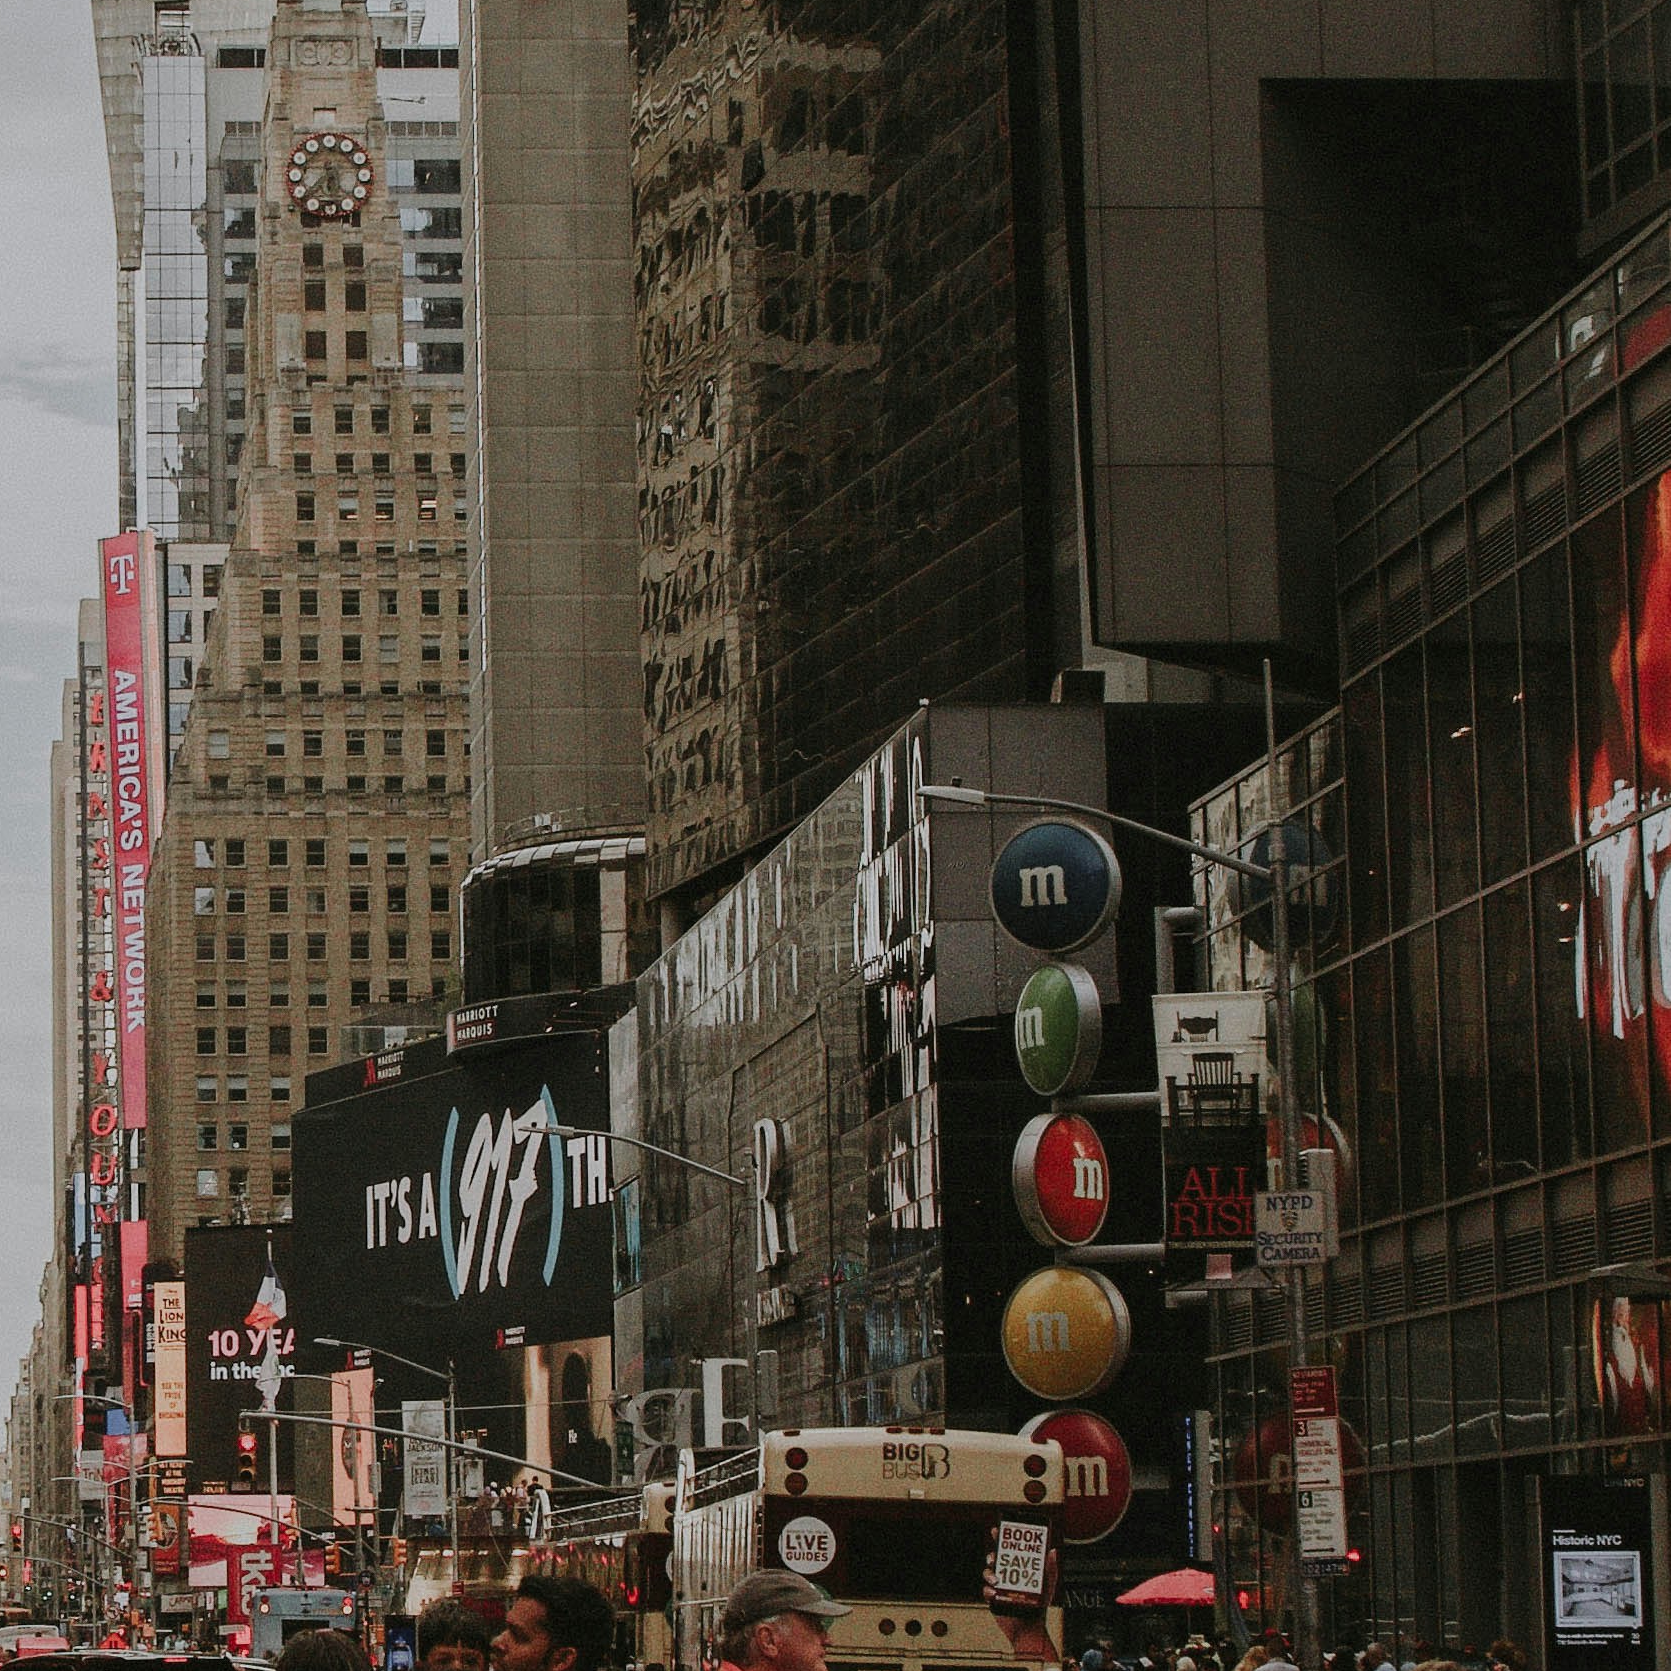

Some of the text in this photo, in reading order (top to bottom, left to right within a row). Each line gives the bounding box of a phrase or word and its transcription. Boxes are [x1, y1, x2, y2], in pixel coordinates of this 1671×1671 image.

[114, 669, 148, 1033] AMERICA'S NETWORK
[1019, 862, 1068, 907] m
[456, 1004, 499, 1024] MARRIOTT
[456, 1022, 493, 1041] MARQUIS
[1018, 1004, 1046, 1050] m
[377, 1050, 405, 1067] MARRIOTT
[1072, 1156, 1105, 1202] m
[1179, 1166, 1253, 1201] ALL
[365, 1175, 414, 1249] IT'S
[418, 1171, 438, 1239] A
[1266, 1195, 1313, 1211] NYPD
[1257, 1231, 1323, 1246] SECURITY
[1260, 1246, 1320, 1261] CAMERA
[163, 1298, 180, 1308] THE
[159, 1309, 184, 1324] LION
[1025, 1310, 1071, 1352] m
[208, 1329, 239, 1357] 10
[210, 1361, 228, 1380] in
[231, 1361, 262, 1380] the
[1297, 1420, 1307, 1437] 3
[882, 1442, 921, 1462] BIG
[882, 1464, 921, 1480] BUS
[1301, 1492, 1310, 1507] 6
[1001, 1527, 1044, 1545] BOOK
[1553, 1534, 1623, 1547] Historic NYC
[1001, 1540, 1043, 1555] ONLINE
[785, 1551, 829, 1563] GUIDES
[999, 1554, 1042, 1570] SAVE
[998, 1568, 1040, 1589] 10%
